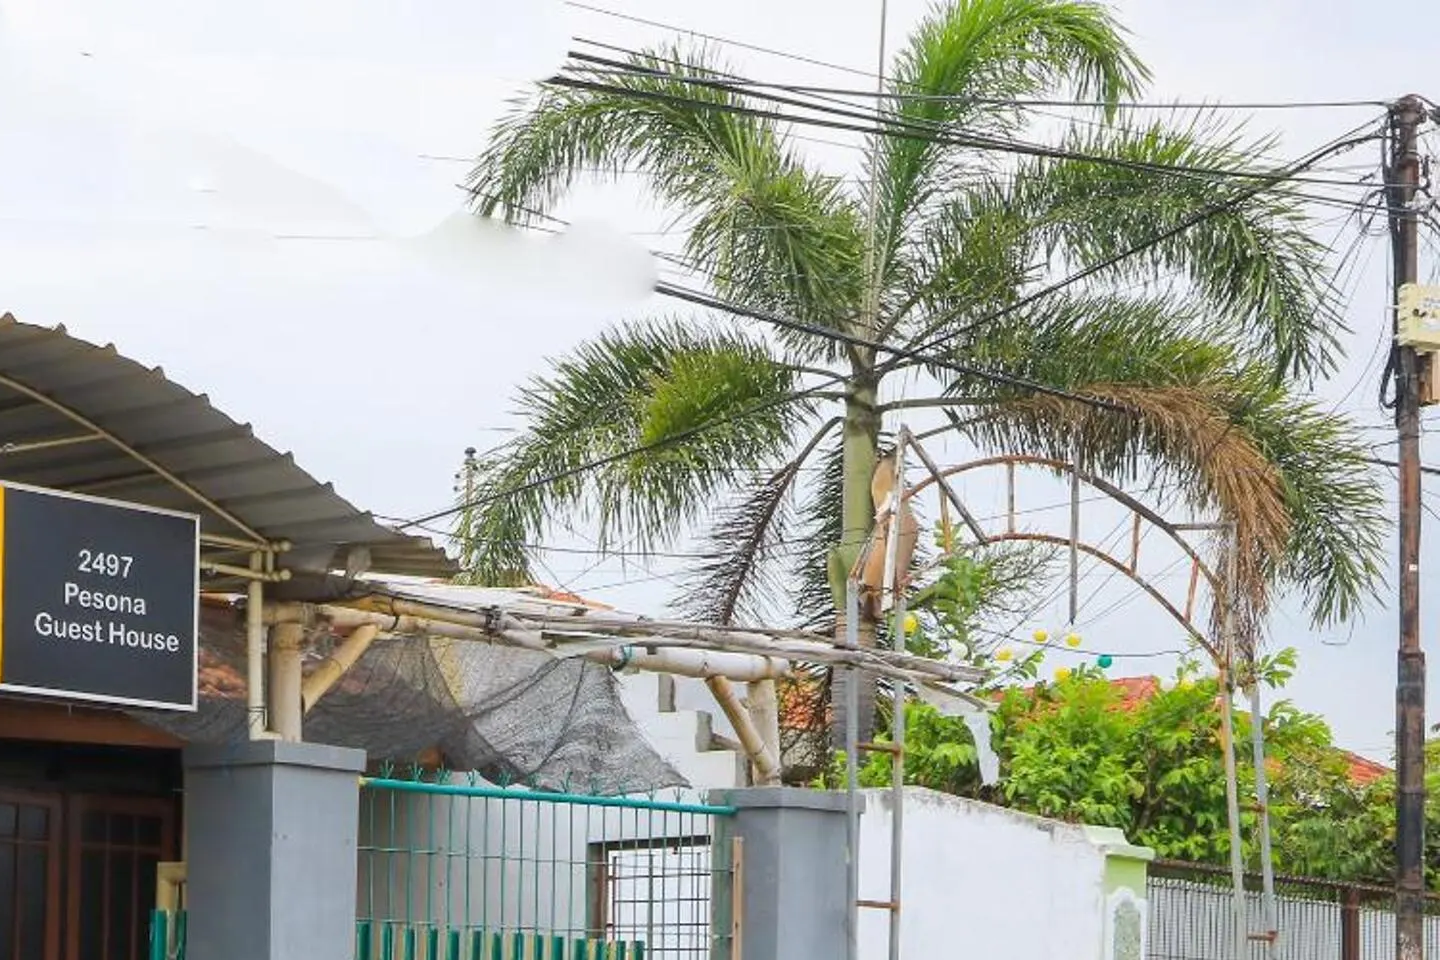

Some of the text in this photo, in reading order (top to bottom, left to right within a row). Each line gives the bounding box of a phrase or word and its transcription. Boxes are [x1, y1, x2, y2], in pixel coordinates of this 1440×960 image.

[78, 548, 134, 579] 2497
[63, 582, 147, 616] Pesona
[34, 611, 180, 652] Guest House
